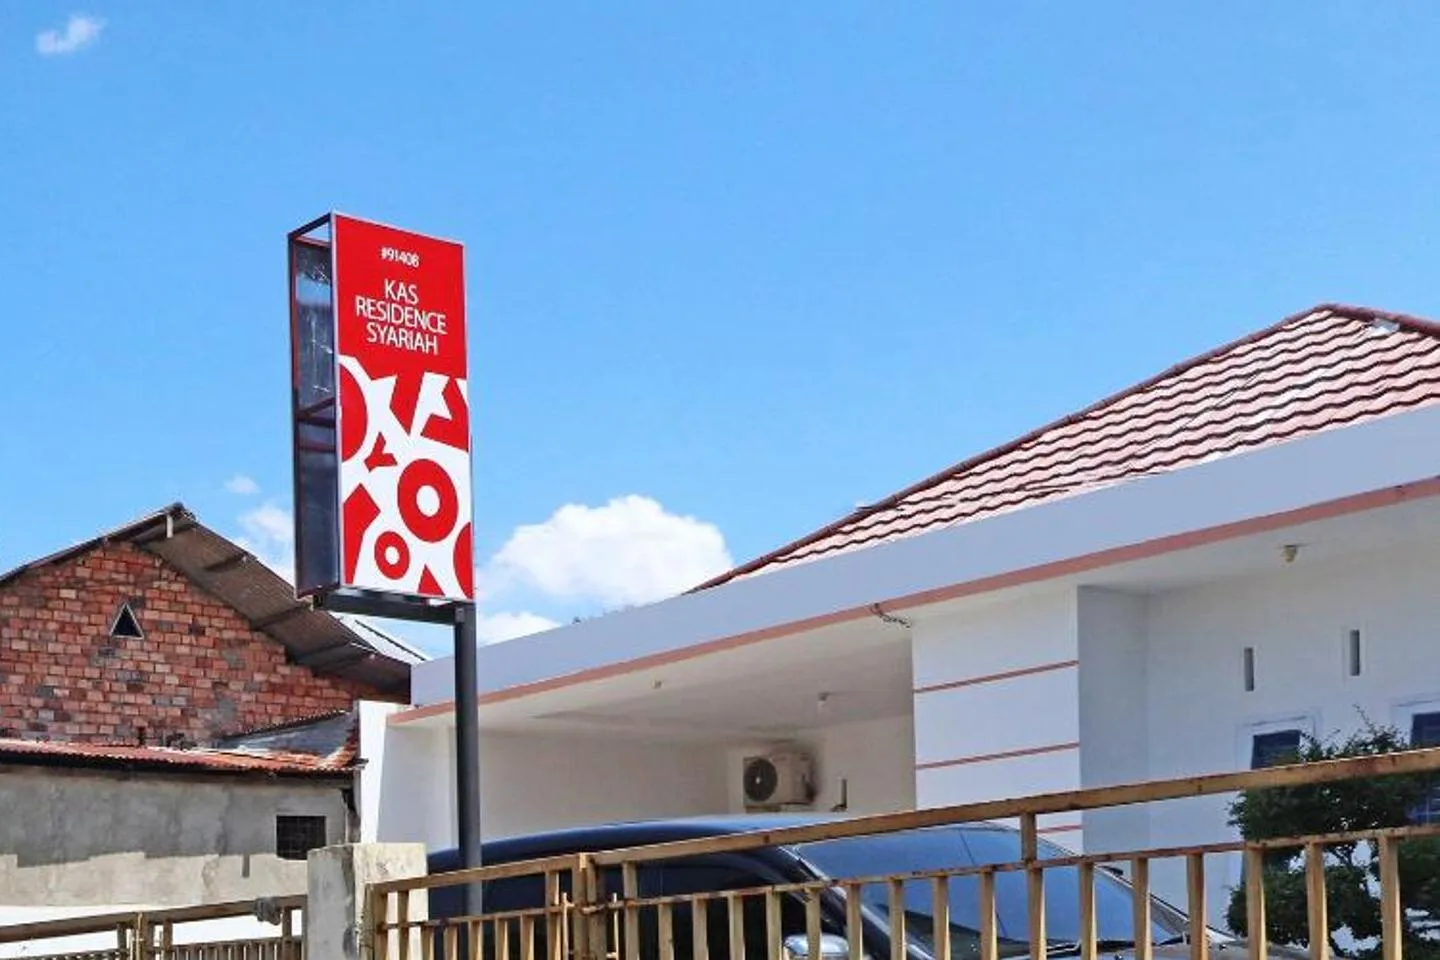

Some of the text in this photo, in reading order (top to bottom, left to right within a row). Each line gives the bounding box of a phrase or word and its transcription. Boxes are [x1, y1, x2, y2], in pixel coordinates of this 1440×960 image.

[381, 247, 420, 268] #91408
[384, 278, 419, 305] KAS
[355, 295, 448, 335] RESIDENCE
[366, 321, 438, 355] SYARIAH
